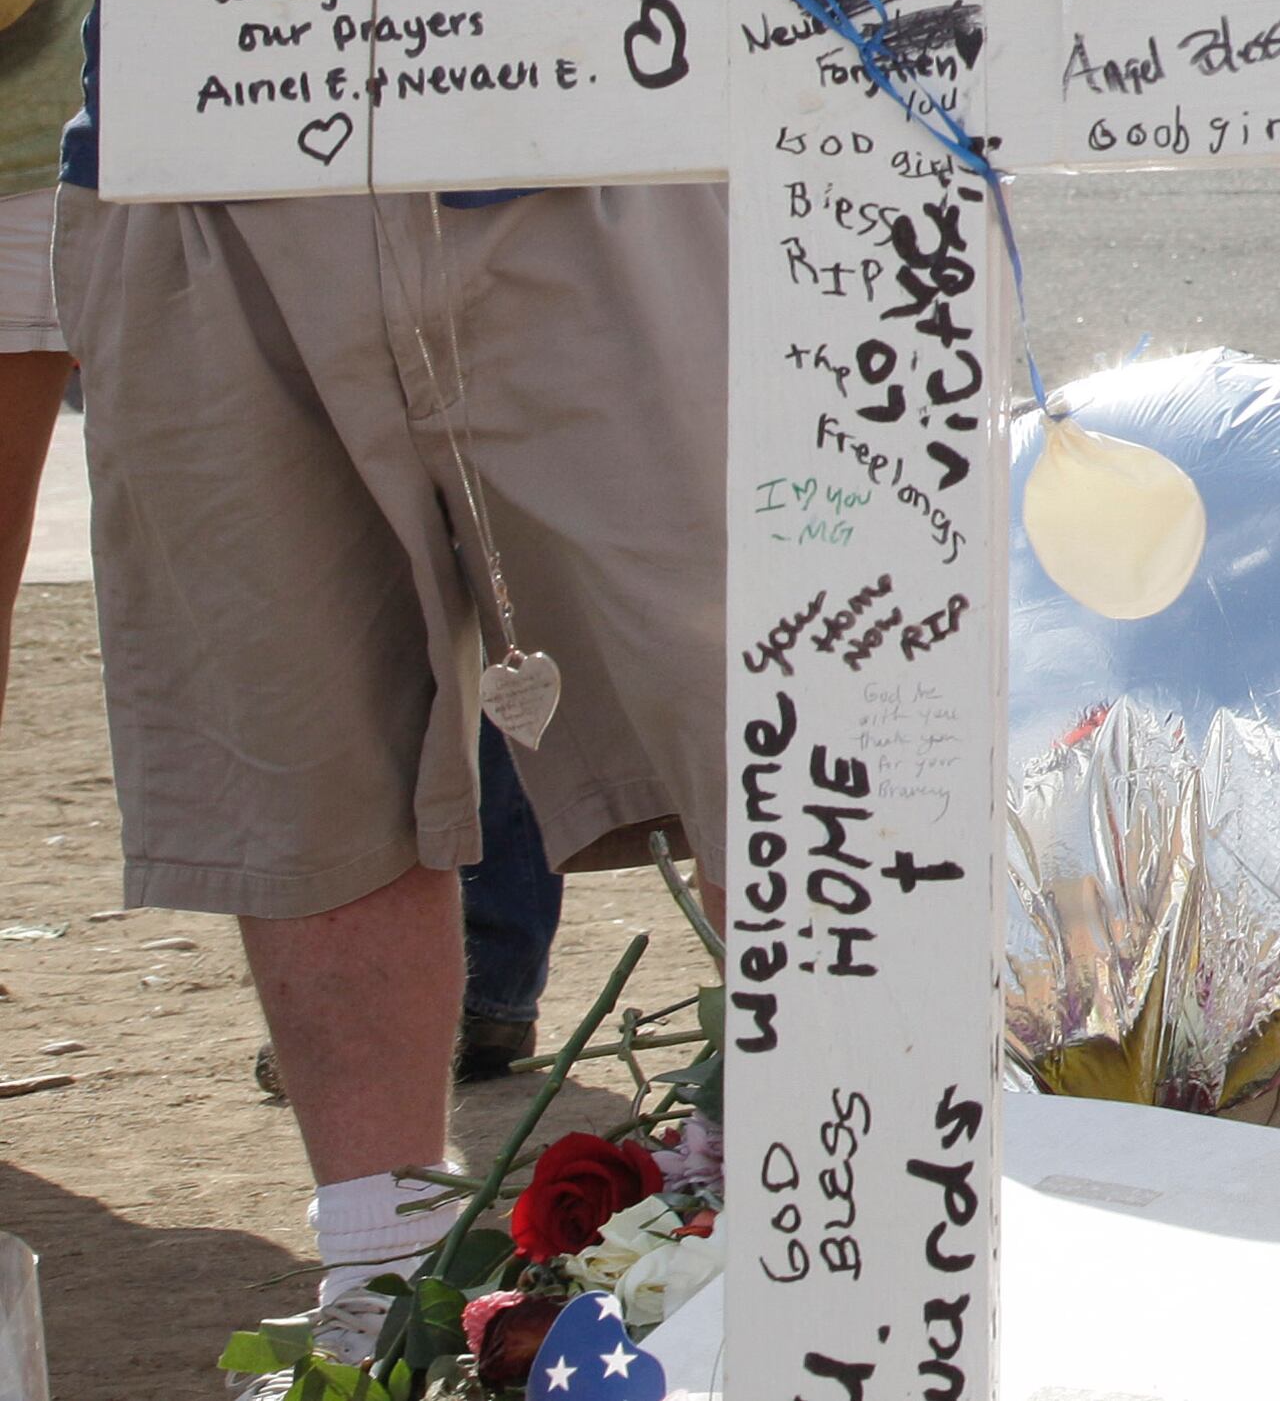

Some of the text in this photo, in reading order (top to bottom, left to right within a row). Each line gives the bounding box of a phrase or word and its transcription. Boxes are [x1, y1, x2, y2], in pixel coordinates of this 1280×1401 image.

[237, 8, 486, 59] our prayers
[741, 13, 834, 55] Neve
[779, 236, 884, 303] RIP
[900, 593, 971, 662] RIP
[802, 743, 880, 978] HOME
[758, 1141, 811, 1284] GOD
[818, 1086, 872, 1282] BLESS
